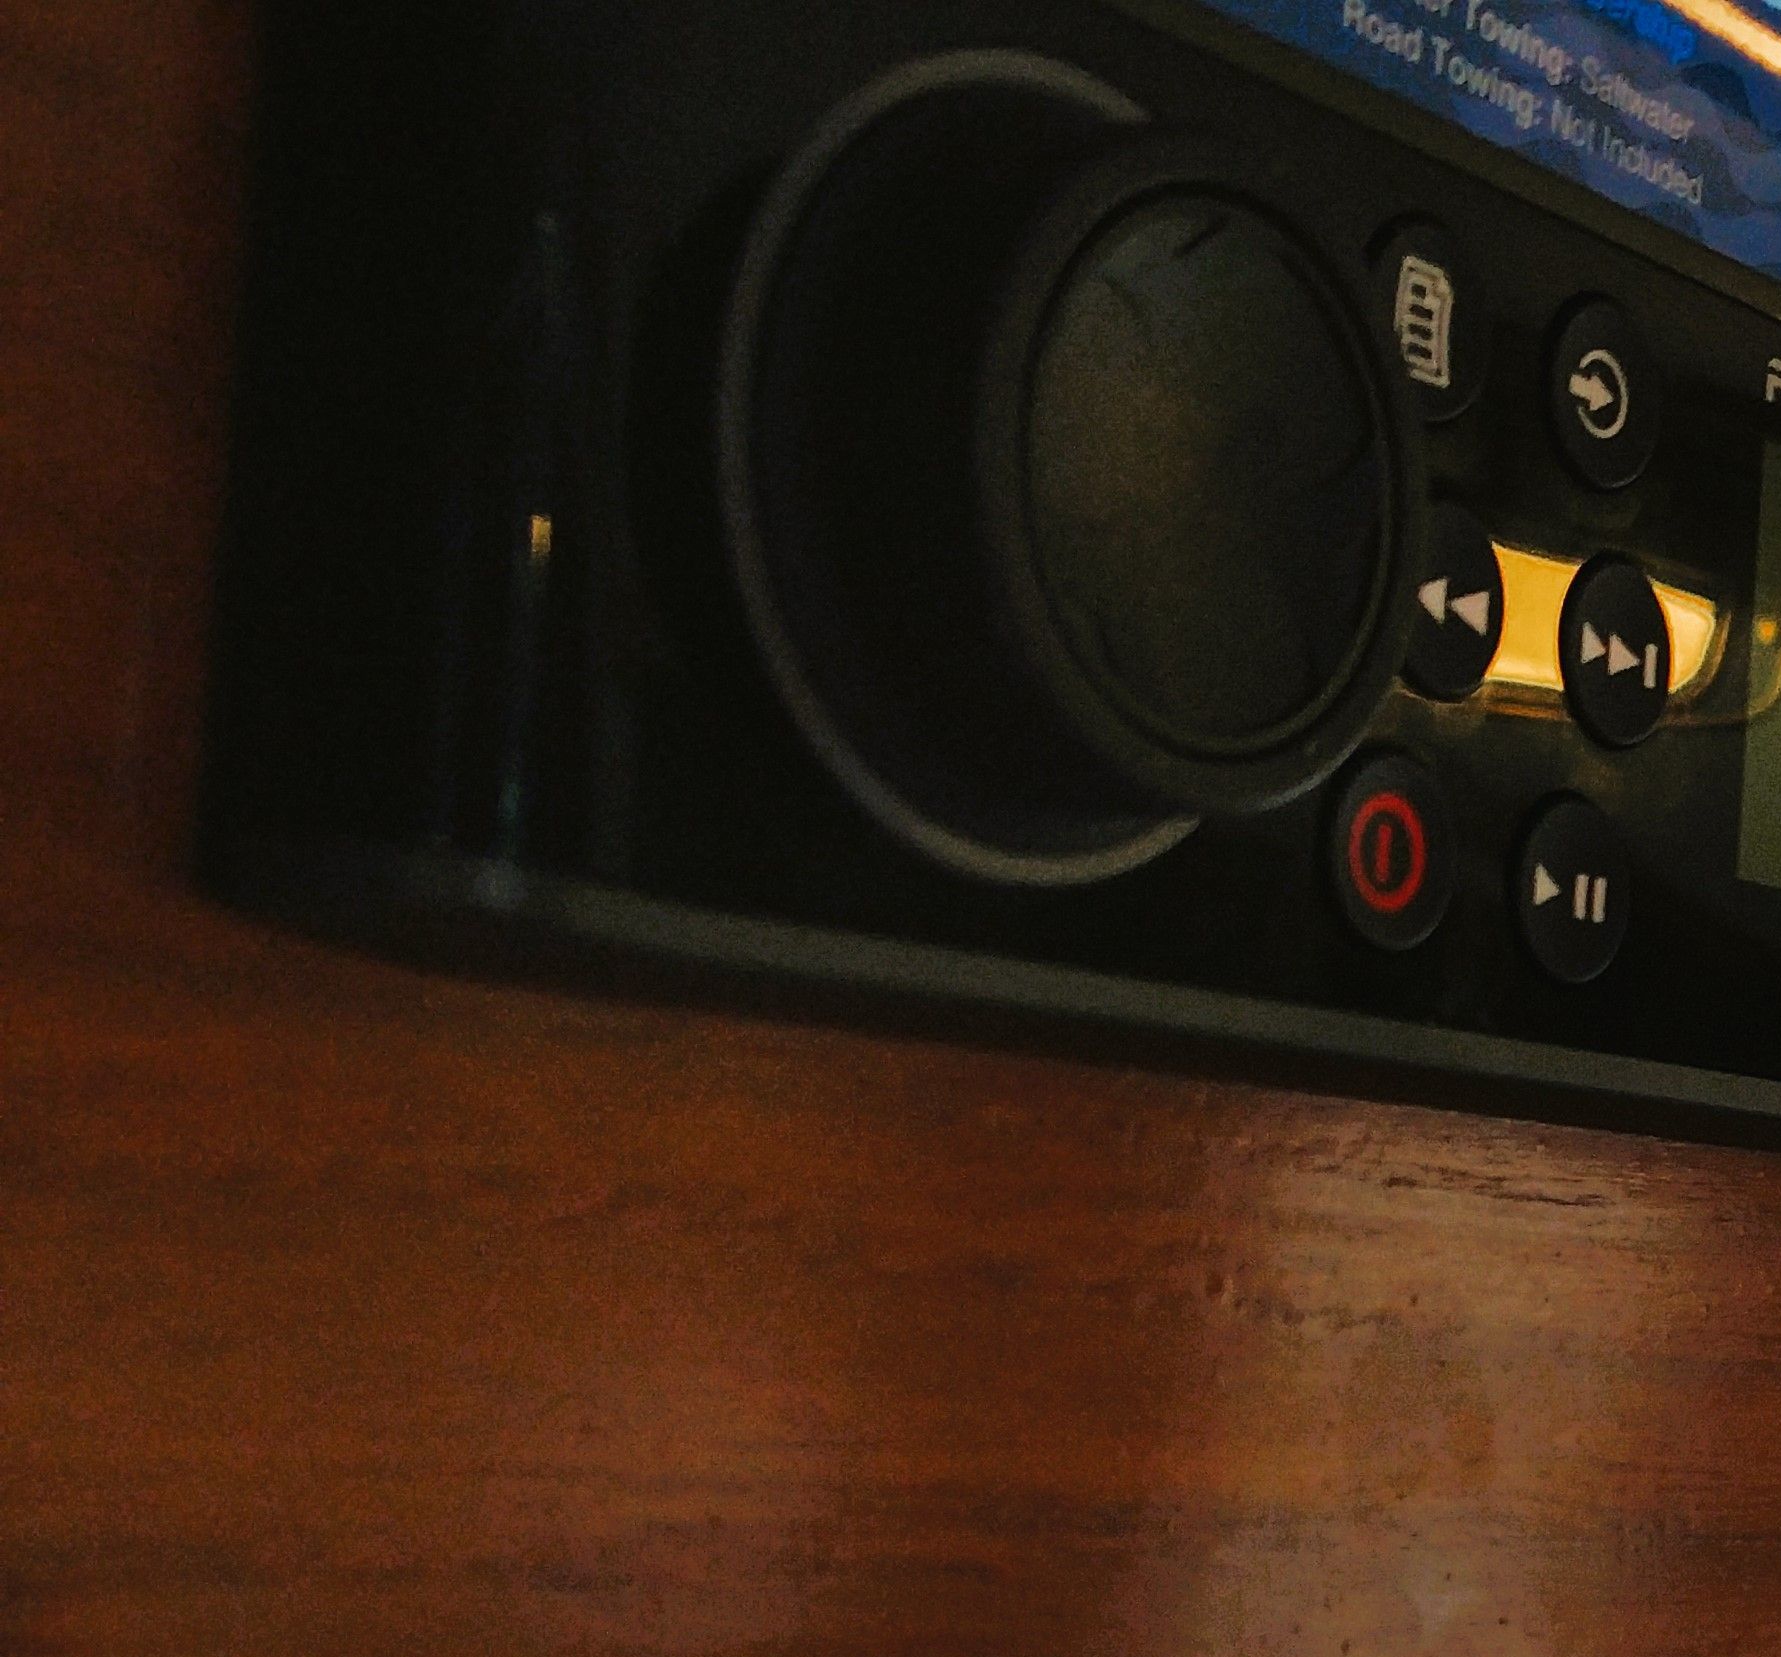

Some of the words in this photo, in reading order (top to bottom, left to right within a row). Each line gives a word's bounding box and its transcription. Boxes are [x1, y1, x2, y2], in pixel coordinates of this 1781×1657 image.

[1342, 0, 1425, 63] Road
[1431, 35, 1543, 130] Towing:
[1551, 98, 1597, 155] Not
[1602, 125, 1703, 205] Included
[1465, 0, 1574, 85] Towing:
[1580, 55, 1695, 144] Saltwater
